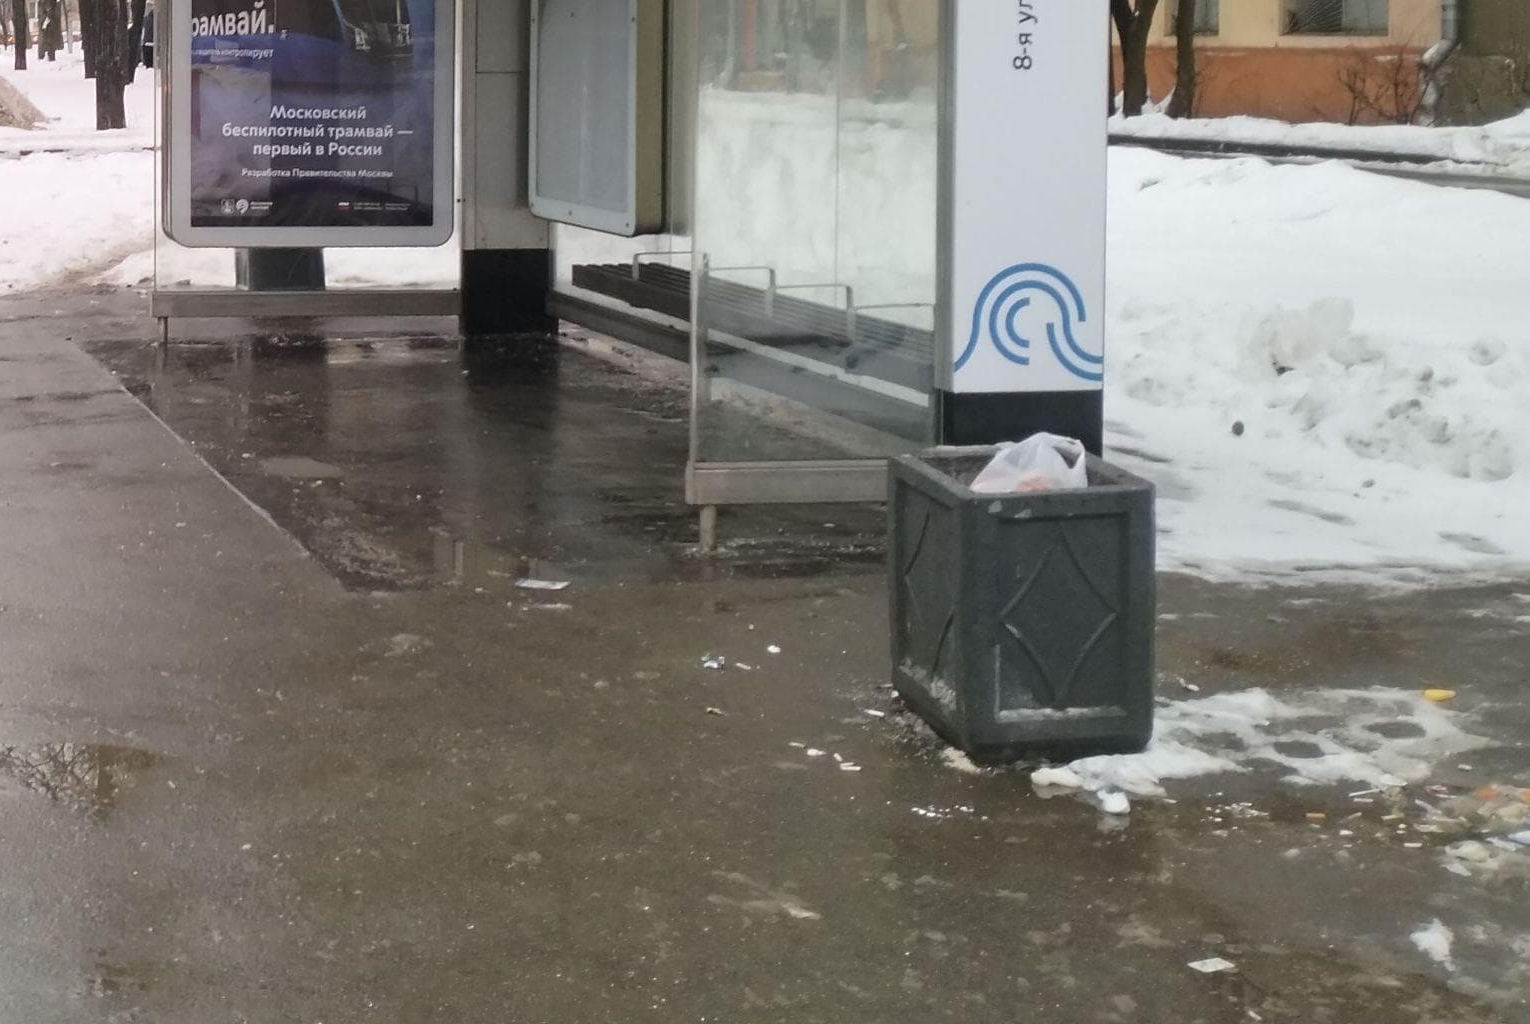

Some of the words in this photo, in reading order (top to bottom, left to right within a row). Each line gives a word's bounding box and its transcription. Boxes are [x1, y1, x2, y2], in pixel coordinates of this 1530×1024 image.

[1012, 32, 1033, 71] 8-я
[270, 104, 367, 120] Московский
[221, 122, 324, 138] беспилотный
[327, 125, 394, 140] трамвай
[253, 141, 312, 158] первый
[315, 145, 325, 156] в
[328, 142, 383, 156] России
[241, 167, 291, 179] Разработка
[292, 167, 356, 179] Правительства
[357, 168, 394, 178] Москвы
